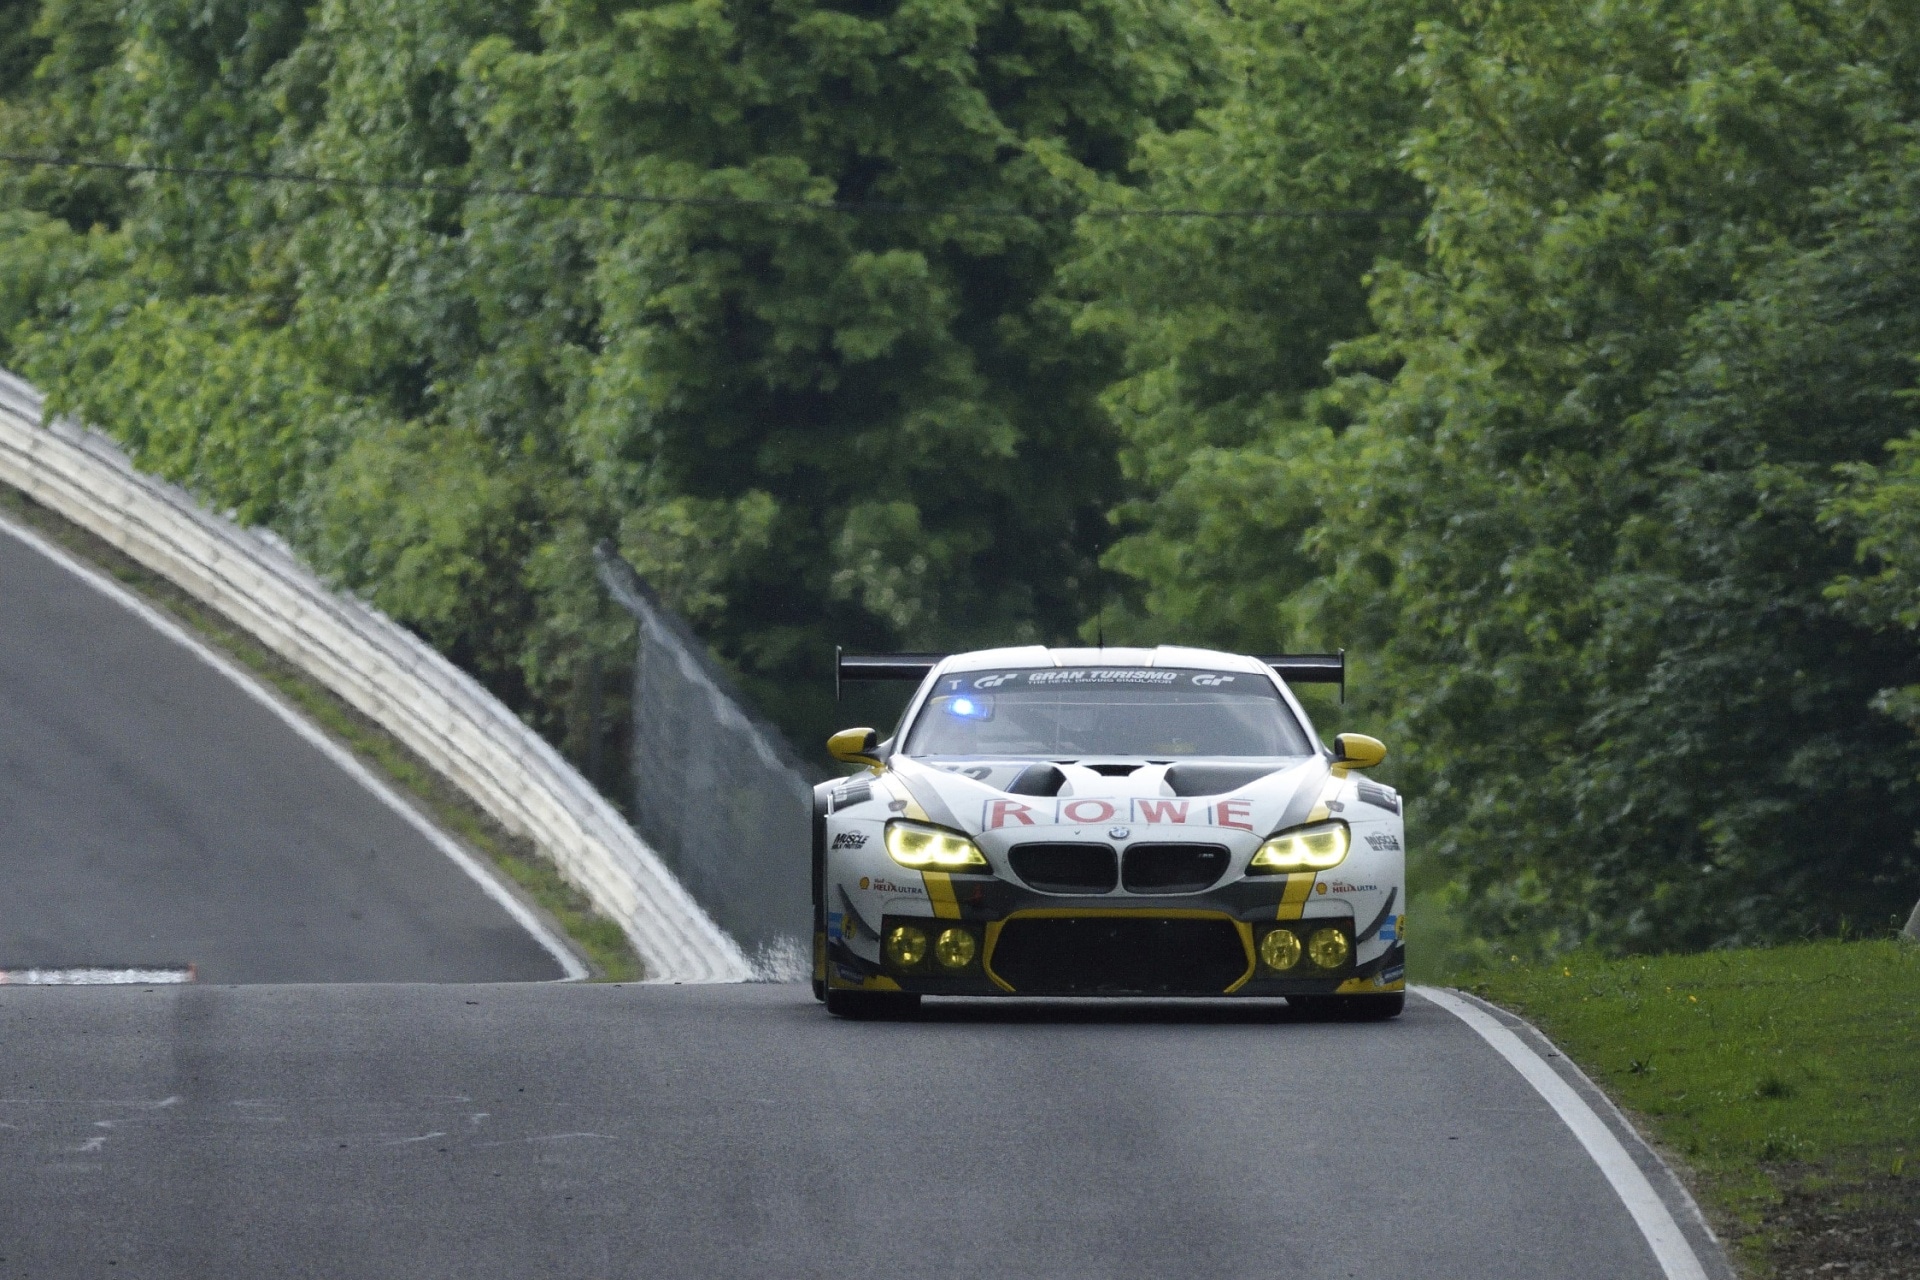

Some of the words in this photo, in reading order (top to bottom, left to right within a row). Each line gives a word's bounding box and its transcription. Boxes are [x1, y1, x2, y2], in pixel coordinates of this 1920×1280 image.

[1029, 671, 1086, 681] GRAN
[1090, 670, 1178, 681] TURISMO
[990, 799, 1254, 831] ROWE
[834, 833, 870, 845] MUSCLE
[873, 882, 897, 892] HELIX
[898, 886, 922, 894] ULTRA
[1333, 884, 1356, 893] HELIX
[1357, 884, 1377, 892] ULTRA
